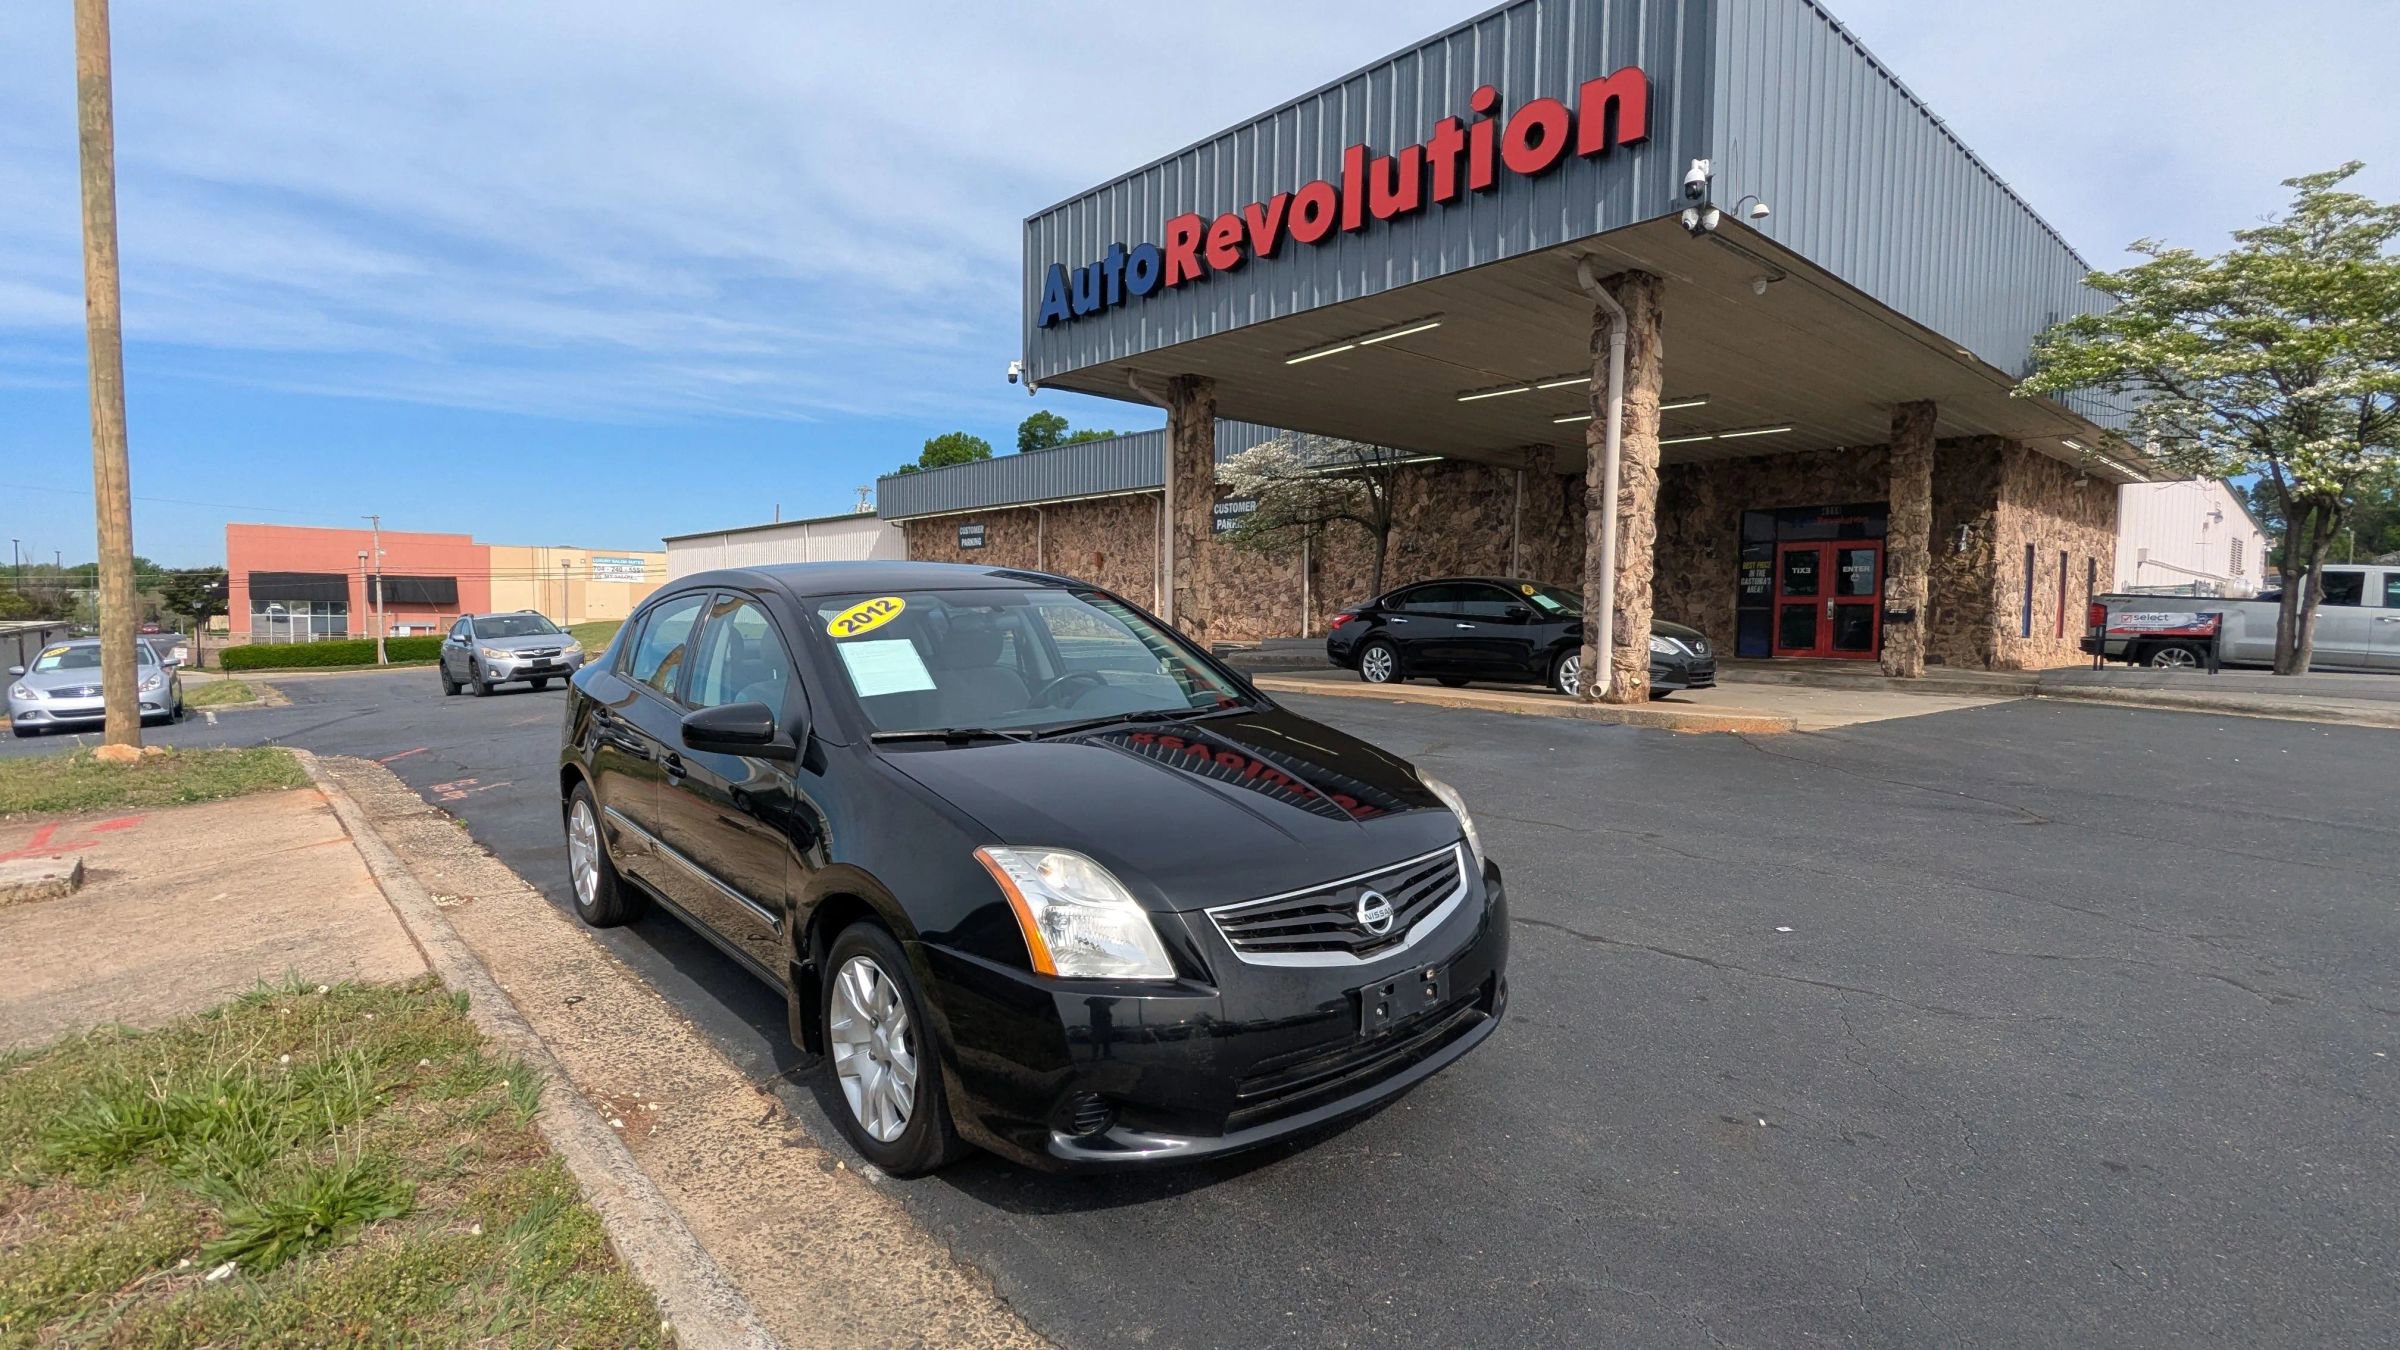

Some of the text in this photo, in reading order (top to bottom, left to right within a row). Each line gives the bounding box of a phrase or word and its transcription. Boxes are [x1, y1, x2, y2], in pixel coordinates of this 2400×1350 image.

[1214, 501, 1256, 514] CUSTOMER
[960, 525, 984, 534] CUSTOMER
[962, 538, 981, 547] PARKING
[838, 600, 897, 633] 2012
